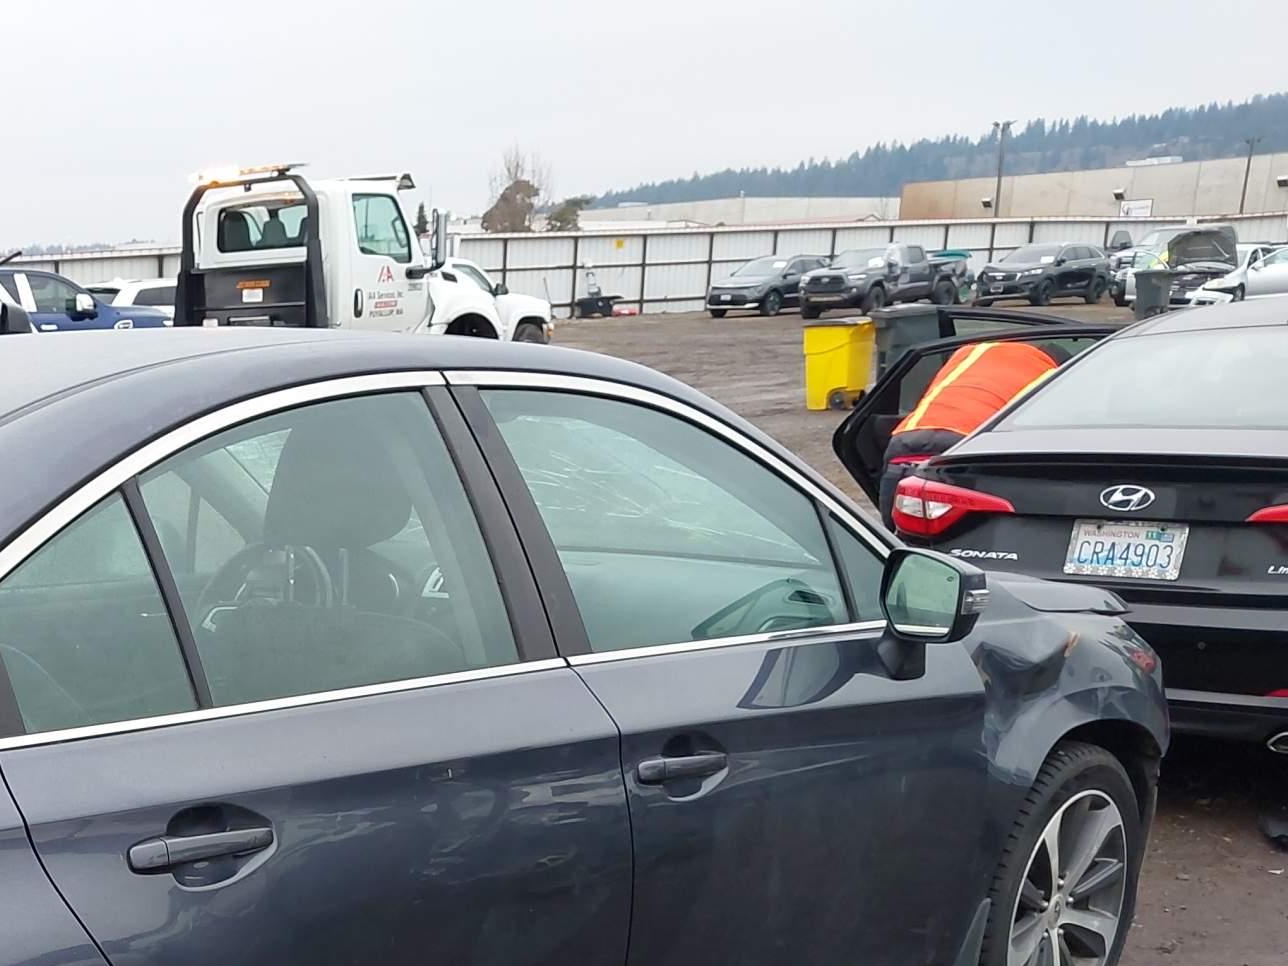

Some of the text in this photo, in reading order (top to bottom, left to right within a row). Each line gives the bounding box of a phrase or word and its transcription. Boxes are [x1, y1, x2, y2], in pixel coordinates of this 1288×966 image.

[1083, 529, 1140, 539] WASHINGTON
[950, 549, 1018, 560] SONATA
[1076, 540, 1173, 569] CRA4903
